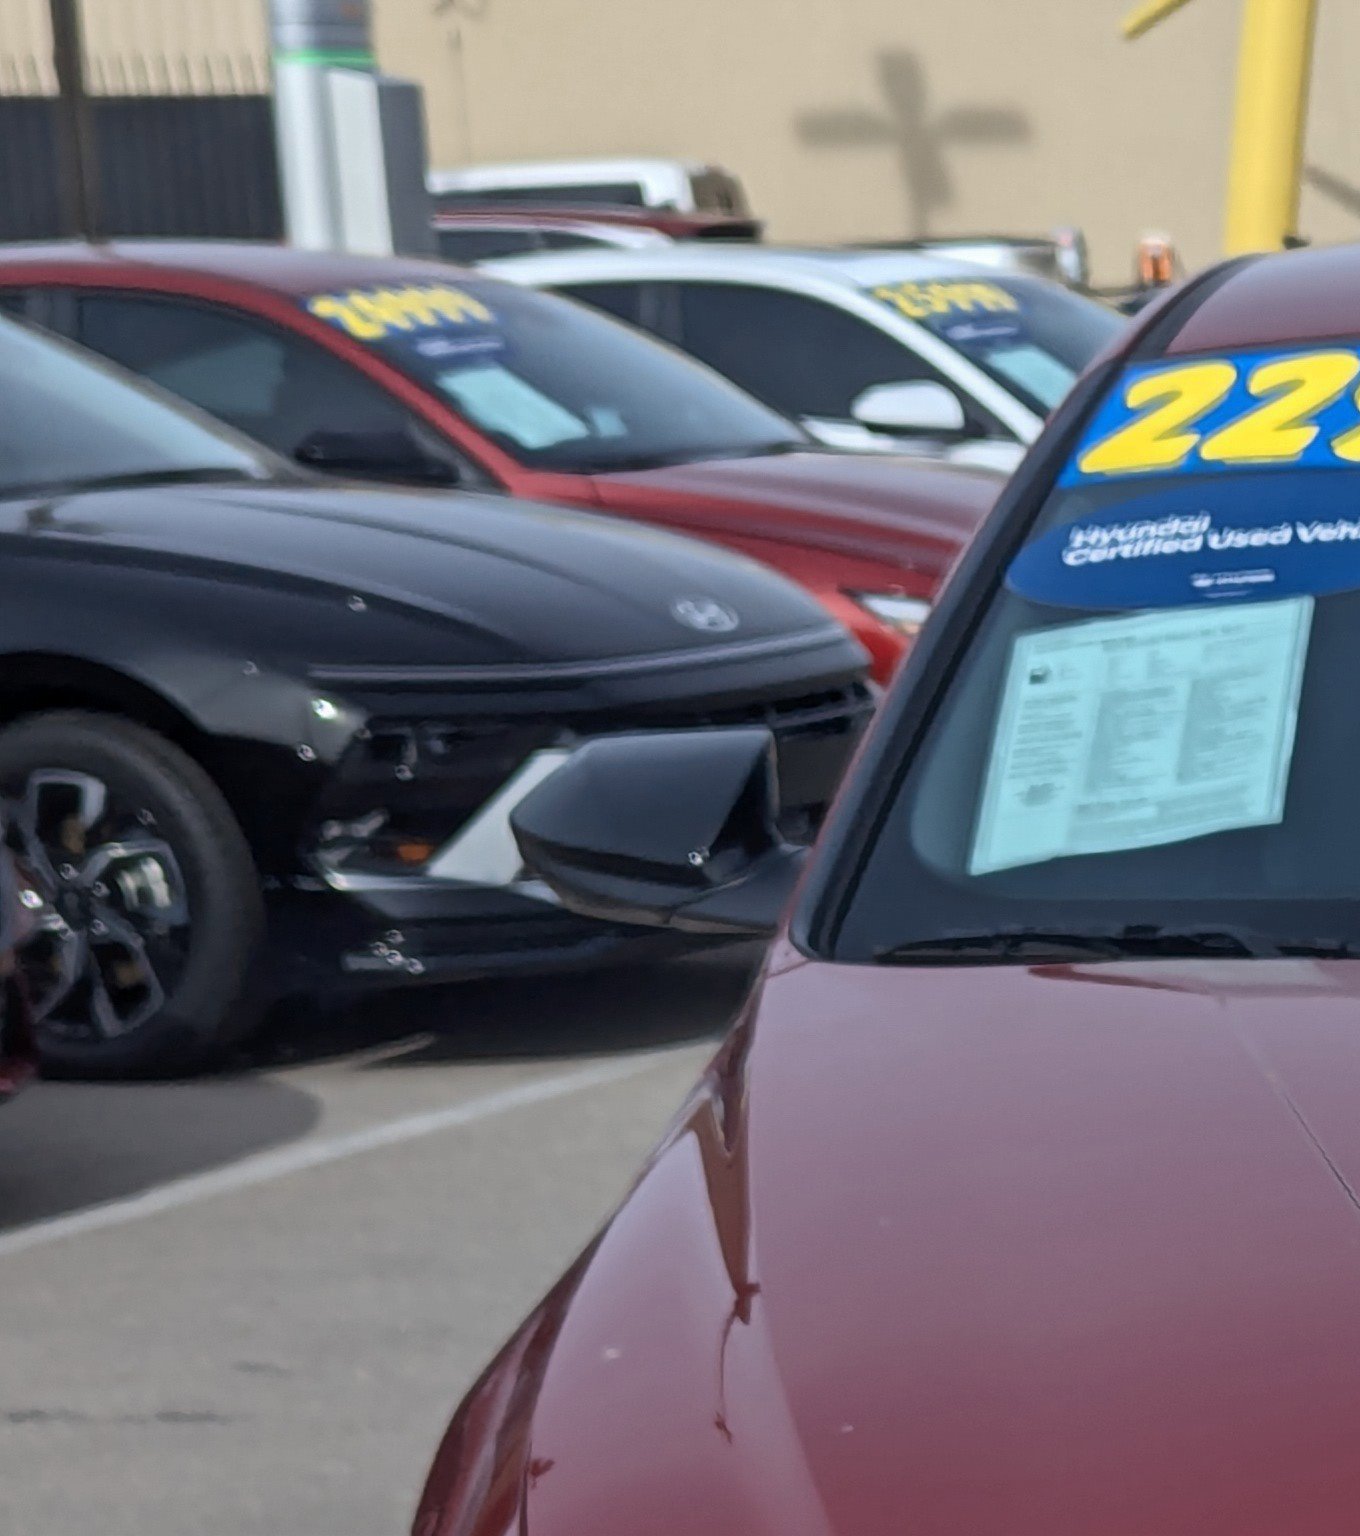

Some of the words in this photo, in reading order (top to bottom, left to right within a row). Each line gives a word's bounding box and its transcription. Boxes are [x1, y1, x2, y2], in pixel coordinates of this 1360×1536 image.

[1061, 536, 1204, 566] Certified
[1207, 522, 1293, 551] Used
[1069, 509, 1212, 548] Hyundai
